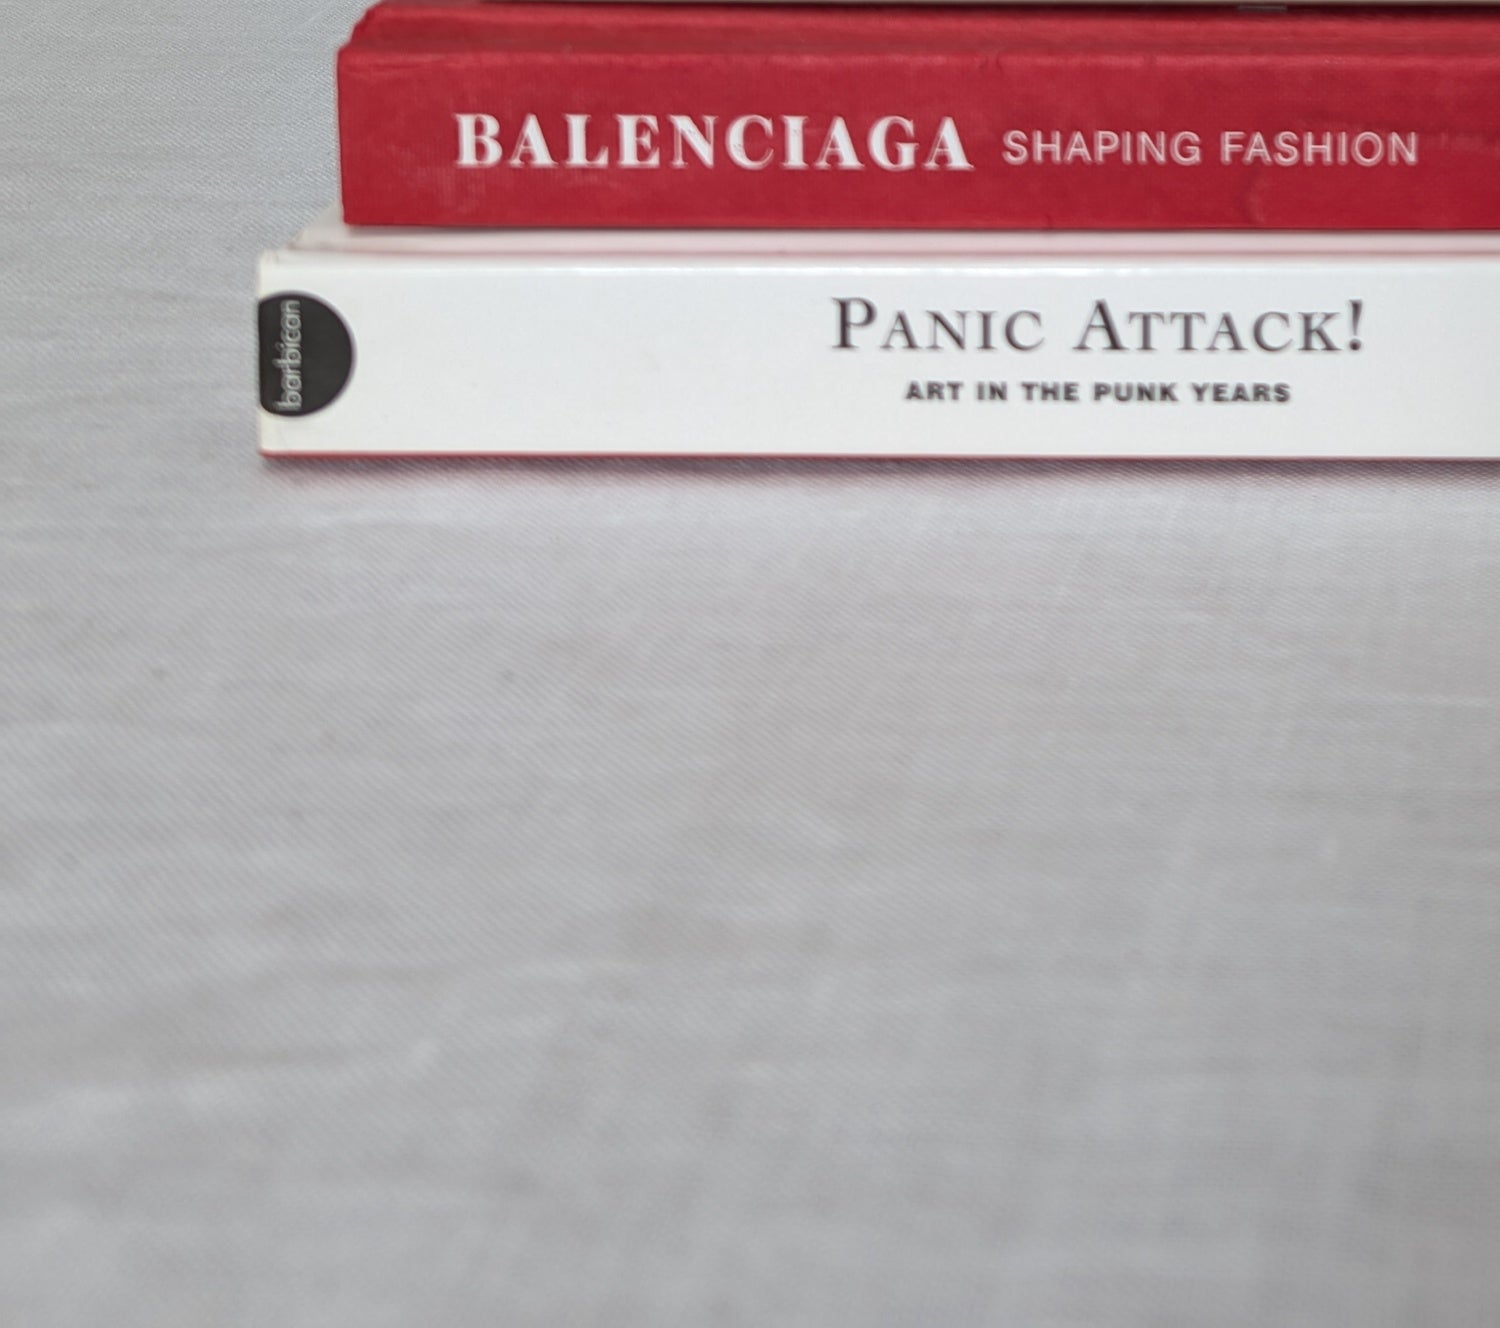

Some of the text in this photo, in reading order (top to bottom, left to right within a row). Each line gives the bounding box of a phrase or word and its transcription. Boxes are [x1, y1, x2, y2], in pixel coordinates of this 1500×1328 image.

[456, 114, 1419, 171] BALENCIAGA SHAPING FASHION
[273, 299, 303, 412] barbican
[905, 381, 1292, 403] ART IN THE PUNK YEARS
